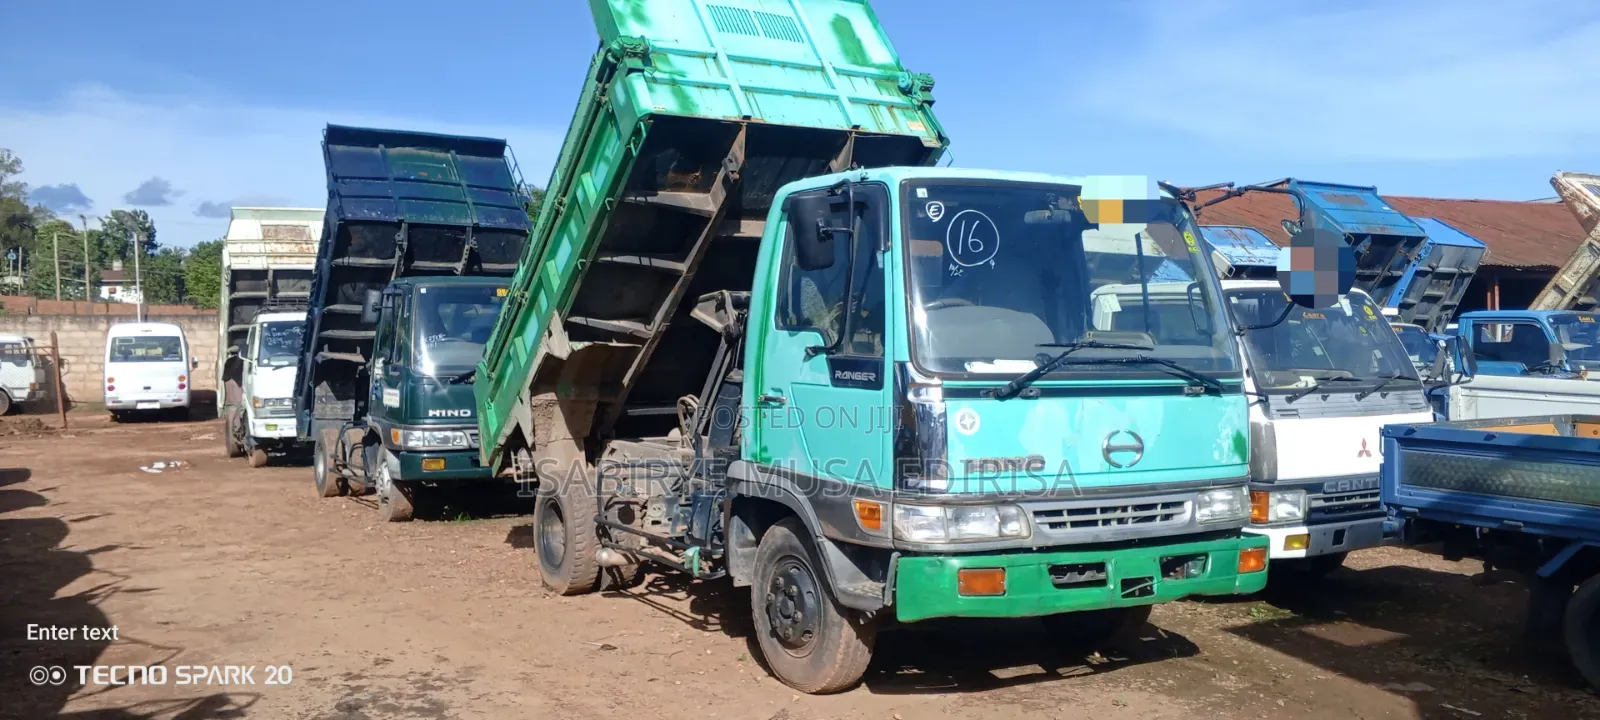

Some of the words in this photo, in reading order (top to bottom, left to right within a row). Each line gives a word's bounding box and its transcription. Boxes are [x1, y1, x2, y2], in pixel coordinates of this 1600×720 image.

[958, 220, 984, 255] 16
[835, 370, 876, 382] RANGER
[428, 409, 471, 417] HINO
[1324, 477, 1379, 493] CANT
